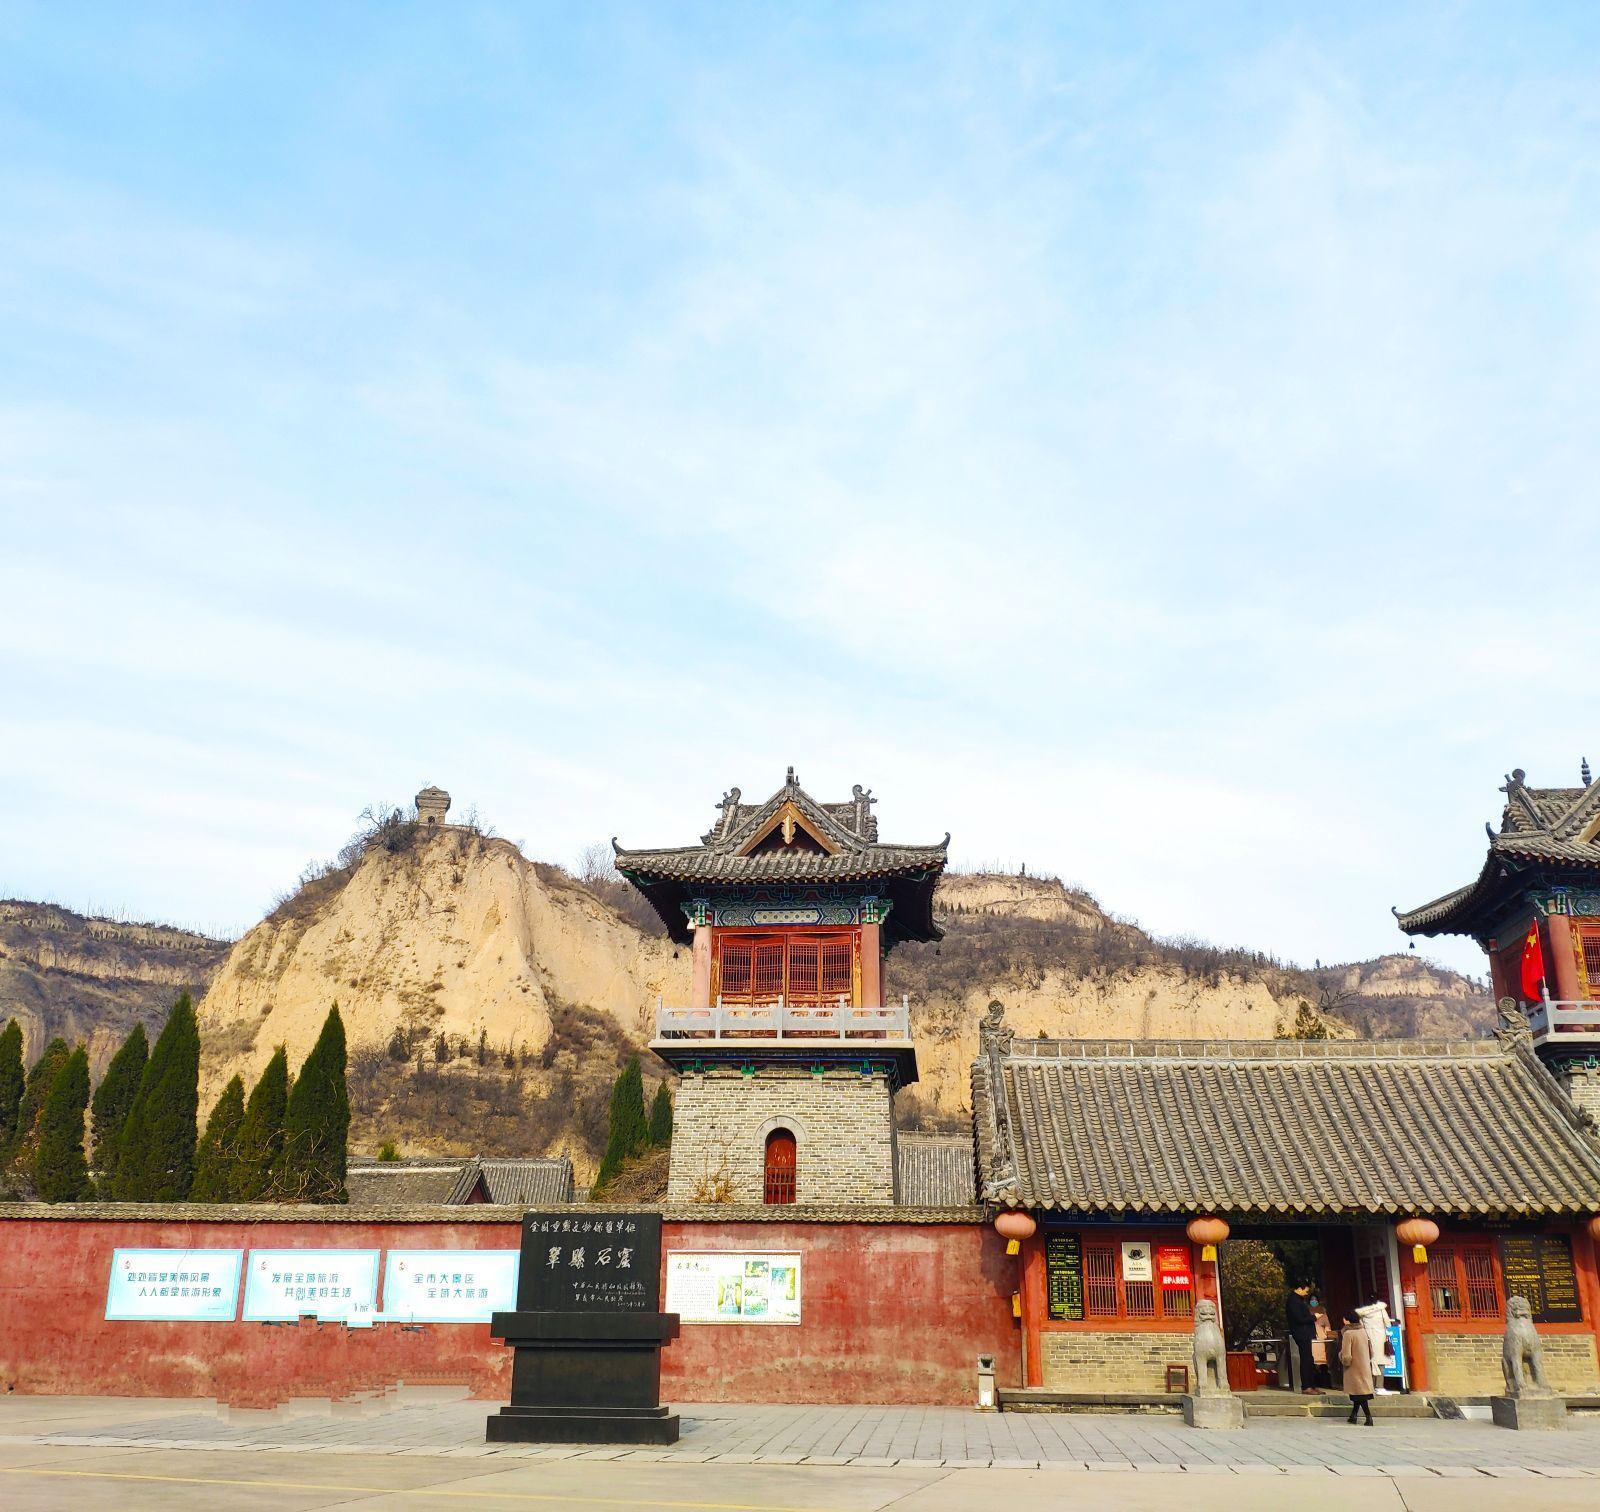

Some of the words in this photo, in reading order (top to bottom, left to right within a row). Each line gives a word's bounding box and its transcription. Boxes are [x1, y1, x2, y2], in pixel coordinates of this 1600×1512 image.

[272, 1272, 339, 1284] 发展全域旅游
[413, 1273, 475, 1285] 全市大景区
[138, 1286, 222, 1298] 人人都是旅游形象
[284, 1286, 352, 1299] 共创美好生活
[426, 1287, 489, 1299] 全域大旅游
